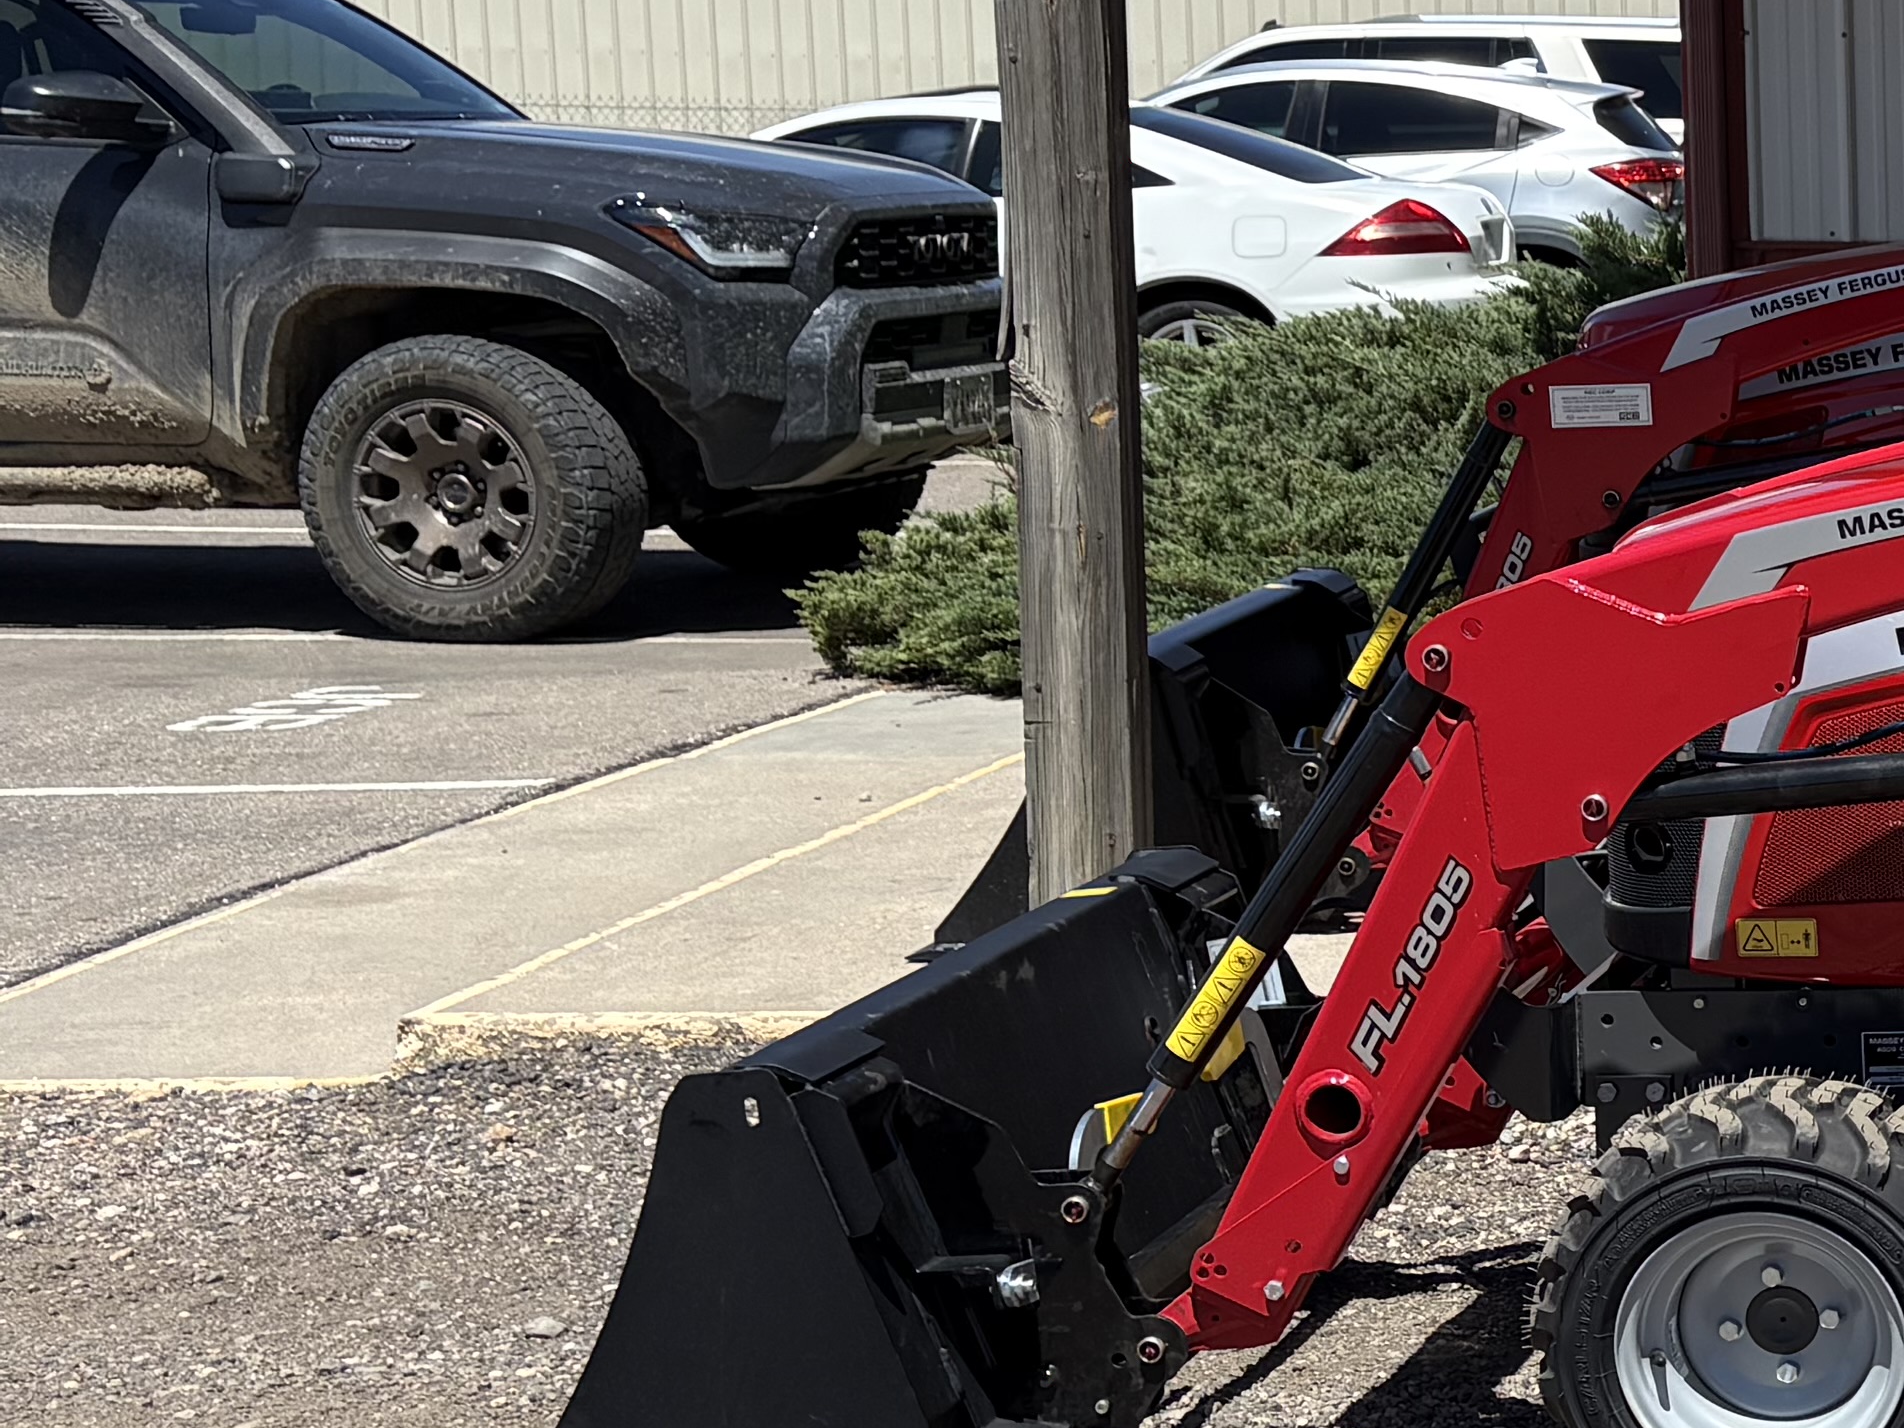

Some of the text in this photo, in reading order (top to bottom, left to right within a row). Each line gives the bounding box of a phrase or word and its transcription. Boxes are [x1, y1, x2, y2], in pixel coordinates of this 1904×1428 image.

[1751, 287, 1834, 319] MASSEY
[1776, 346, 1882, 384] MASSEY
[1350, 858, 1471, 1073] FL.1805
